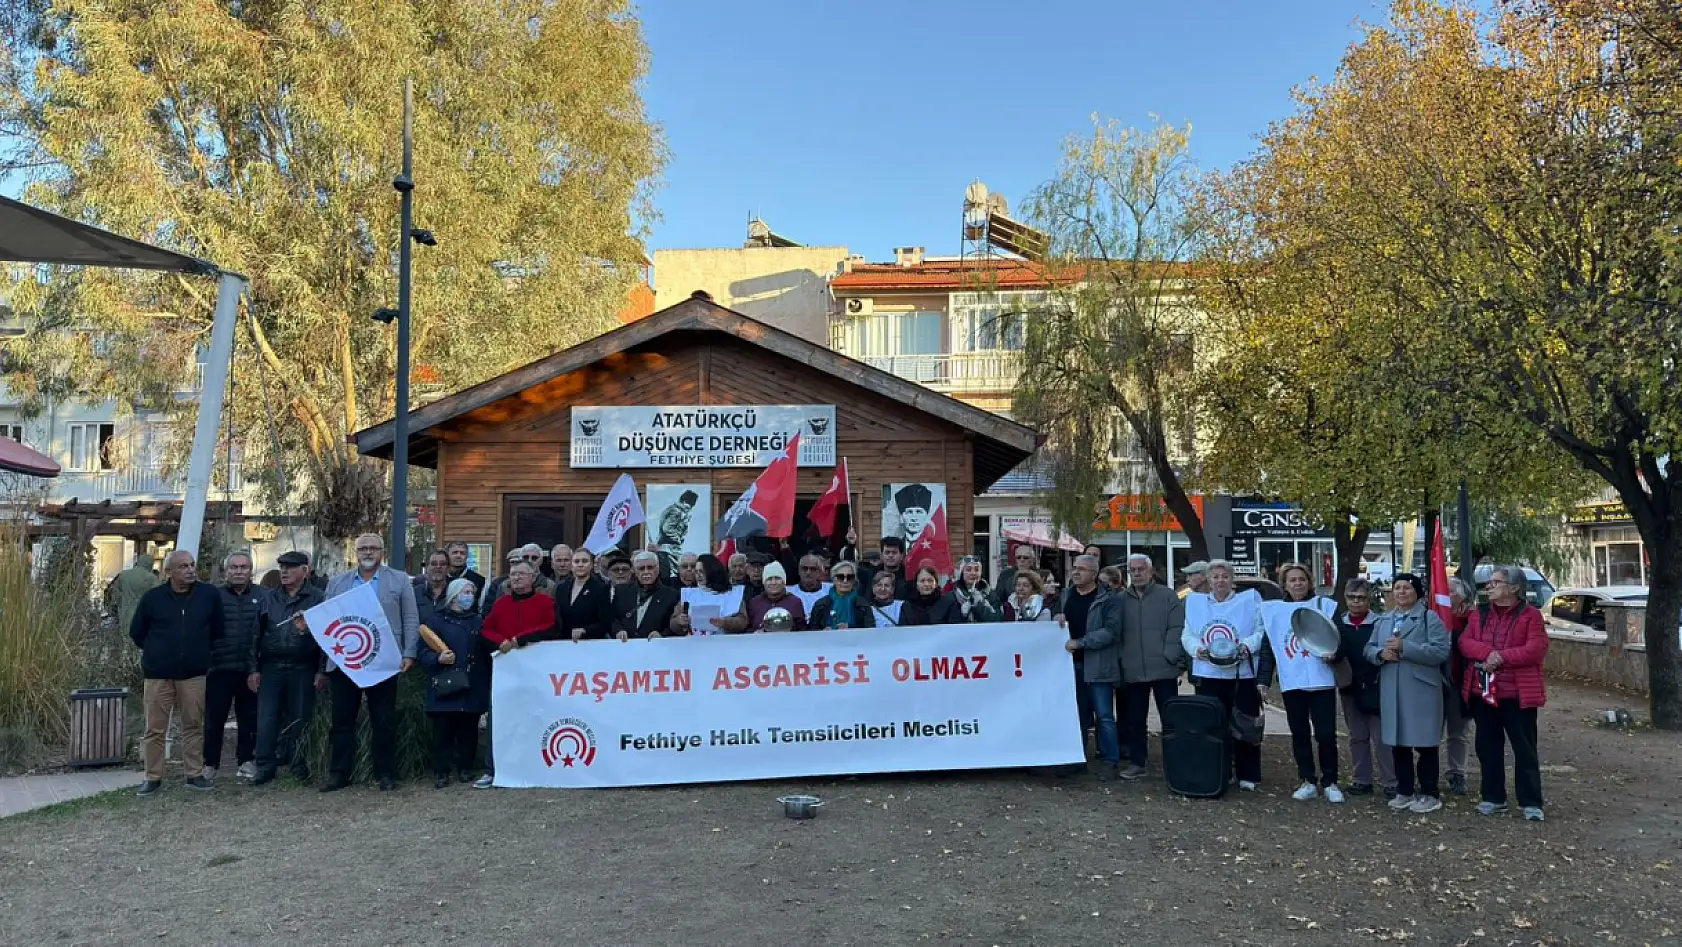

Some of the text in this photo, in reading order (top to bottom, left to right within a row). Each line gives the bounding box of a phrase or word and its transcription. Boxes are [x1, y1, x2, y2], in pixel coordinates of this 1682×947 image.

[652, 410, 757, 432] ATATÜRKÇÜ
[618, 432, 703, 455] DÜŞÜNCE
[709, 431, 788, 451] DERNEĞİ
[650, 452, 756, 467] FETHİYE ŞUBESİ
[549, 653, 1023, 703] YAŞAMIN ASGARİSİ OLMAZ !
[620, 719, 979, 752] Fethiye Halk Temsilcileri Meclisi
